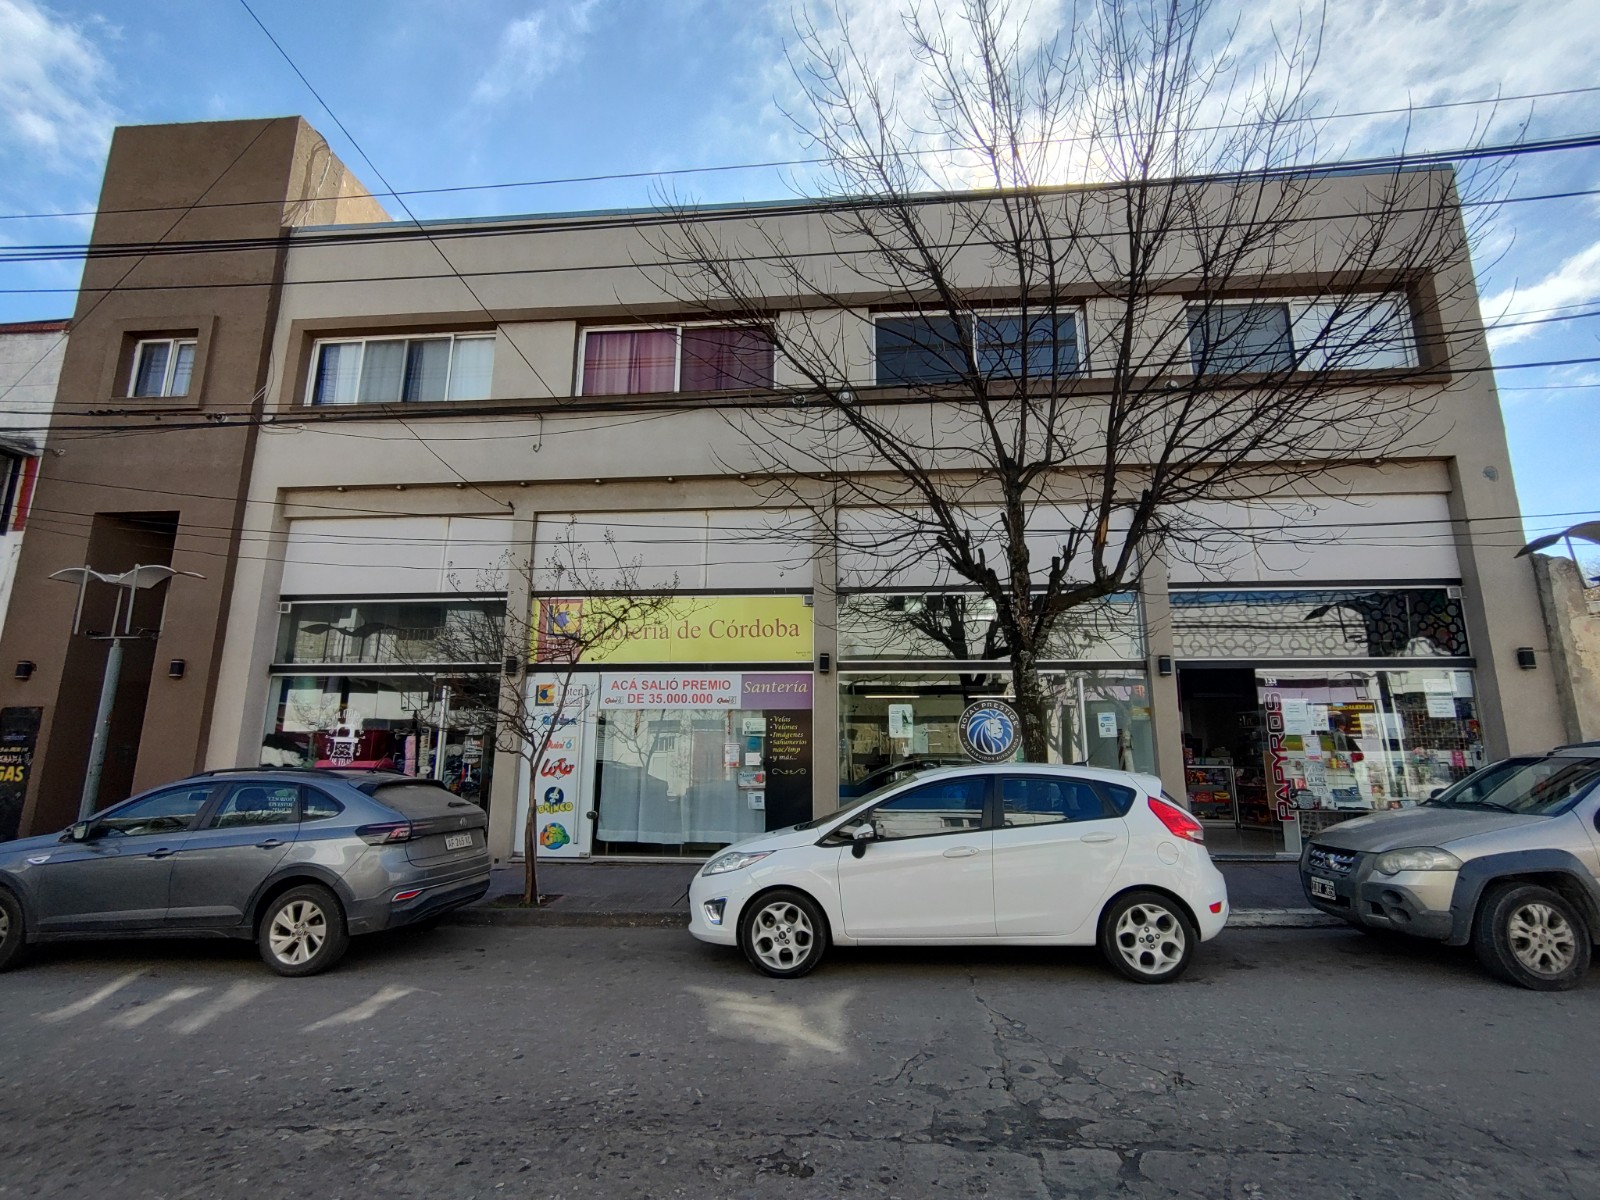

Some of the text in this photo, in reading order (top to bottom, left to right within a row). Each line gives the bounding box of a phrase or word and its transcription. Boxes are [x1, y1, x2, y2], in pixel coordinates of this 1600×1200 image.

[677, 620, 701, 639] de
[709, 618, 800, 639] Córdoba
[611, 677, 731, 690] ACÁ SALIÓ PREMIO
[743, 680, 808, 694] Santería
[627, 693, 713, 704] DE 35.000.000
[773, 715, 792, 723] Velas
[960, 702, 1019, 729] ROYAL PRESTIGE
[1264, 691, 1297, 821] PAPYROS
[537, 802, 574, 815] BRINCO
